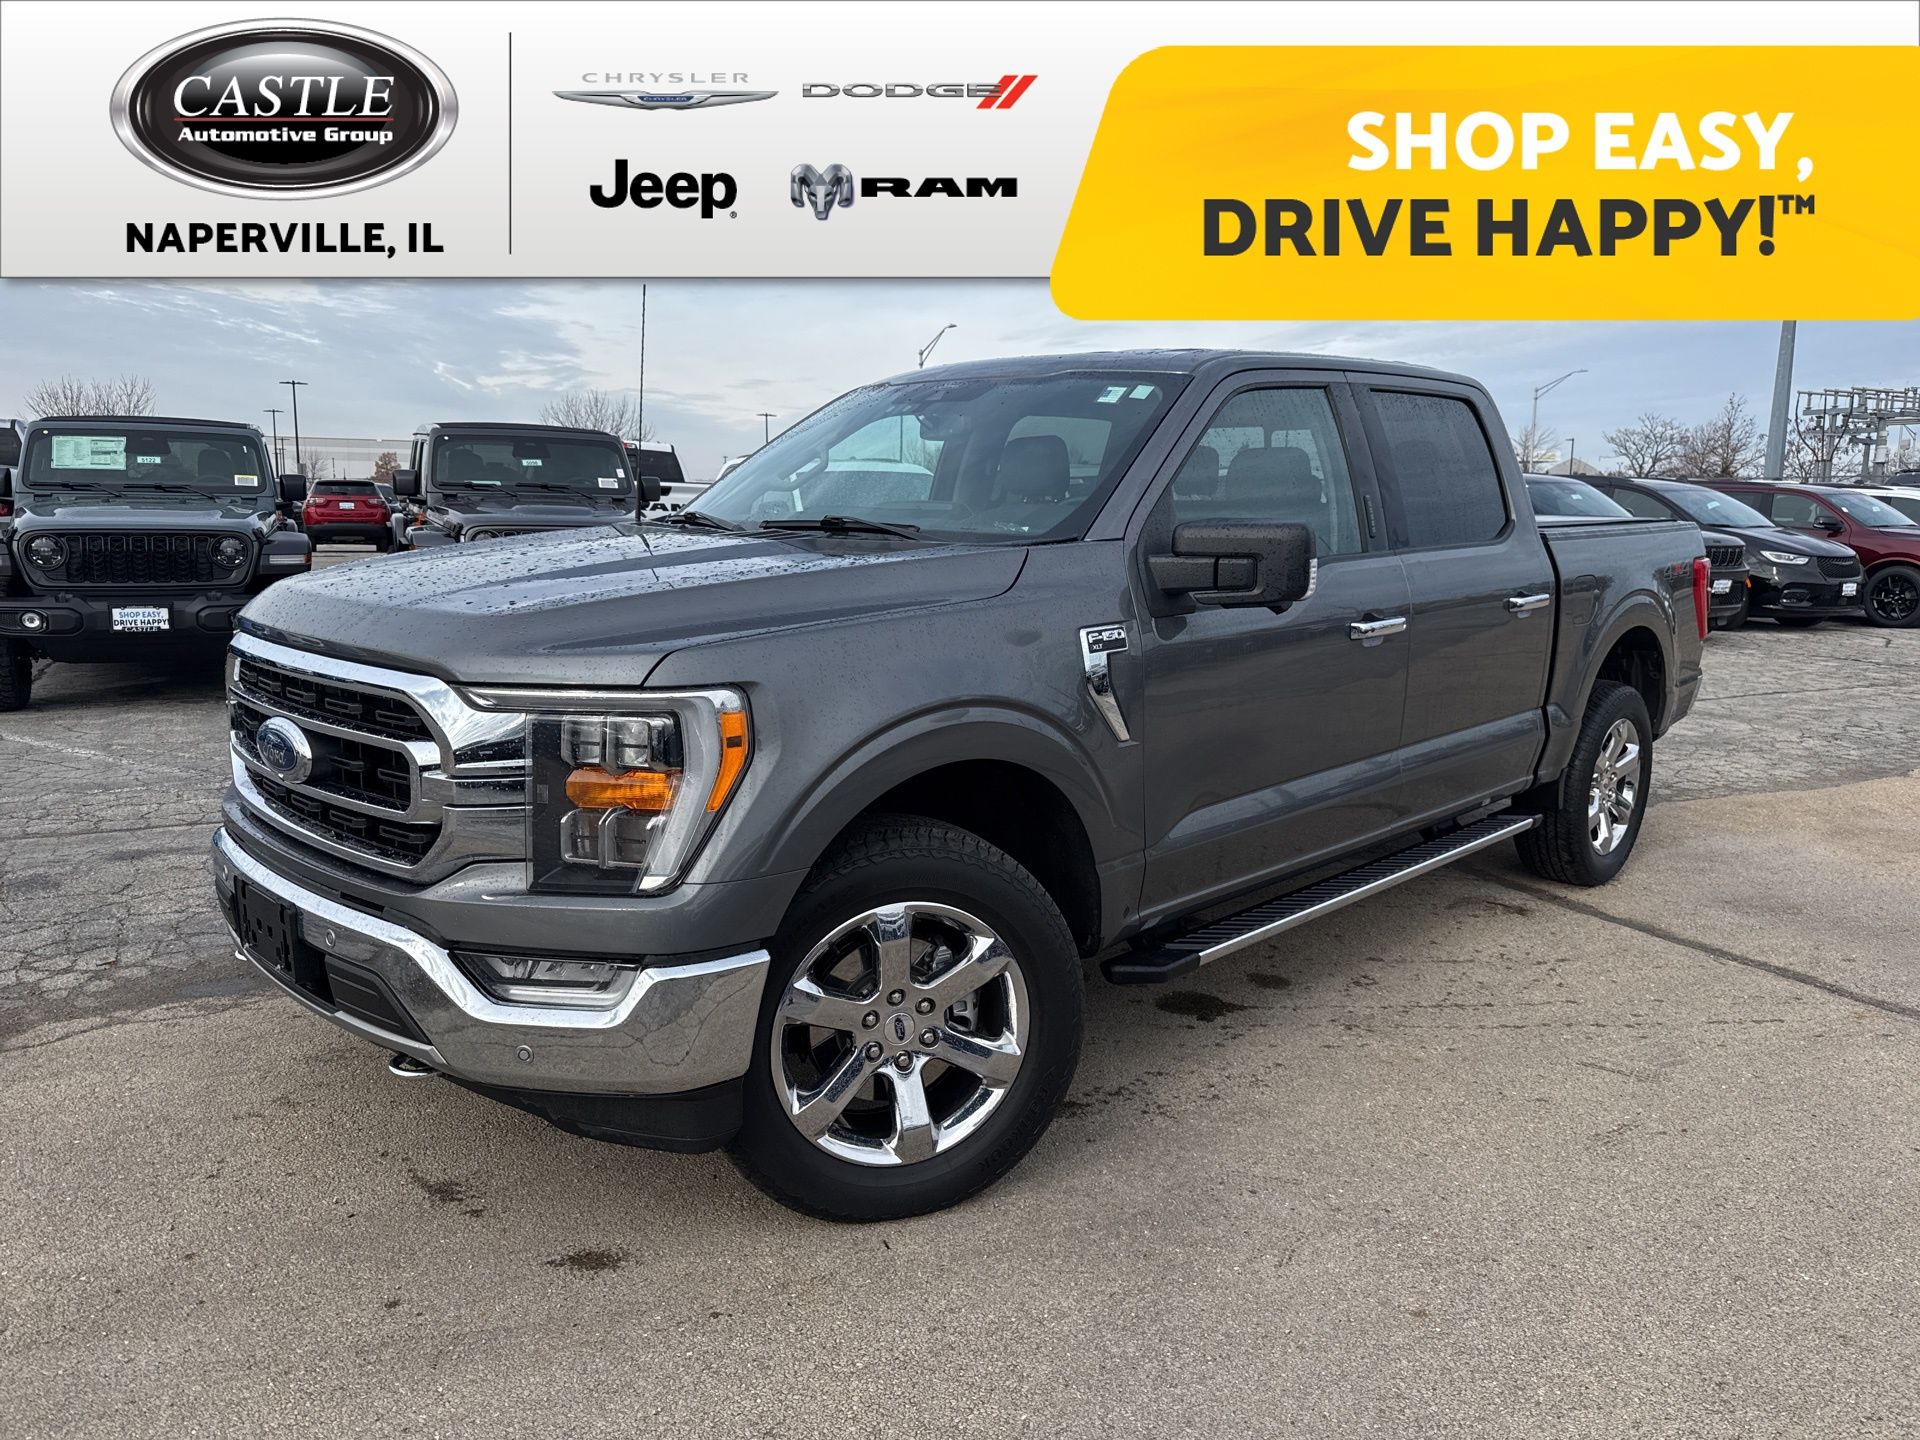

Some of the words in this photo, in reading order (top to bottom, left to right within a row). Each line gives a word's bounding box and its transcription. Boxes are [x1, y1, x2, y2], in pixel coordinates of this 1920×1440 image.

[119, 611, 141, 619] SHOP
[114, 619, 139, 627] DRIVE
[1087, 629, 1126, 643] F-150
